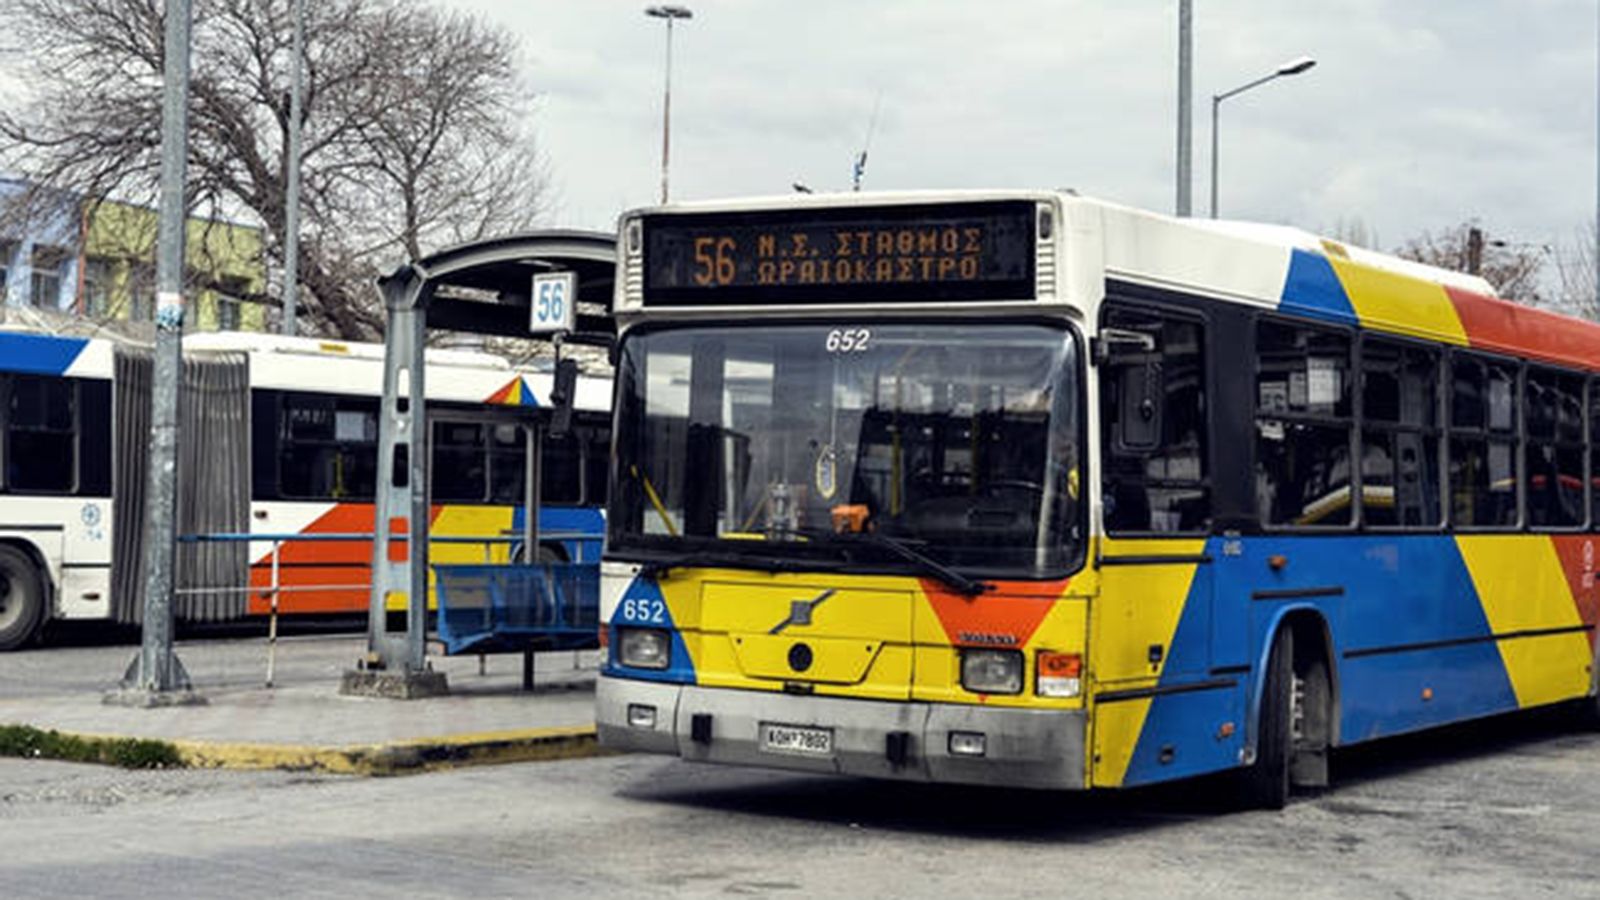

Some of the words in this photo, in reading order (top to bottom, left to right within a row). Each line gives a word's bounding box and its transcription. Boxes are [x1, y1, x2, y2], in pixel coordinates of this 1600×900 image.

[836, 228, 981, 256] ΣΤΑΘΜΟΣ
[694, 237, 737, 285] 56
[757, 256, 978, 284] ΩΡΑΙΟΚΑΣΤΡΟ
[538, 282, 563, 322] 56
[826, 329, 870, 352] 652
[624, 599, 664, 623] 652
